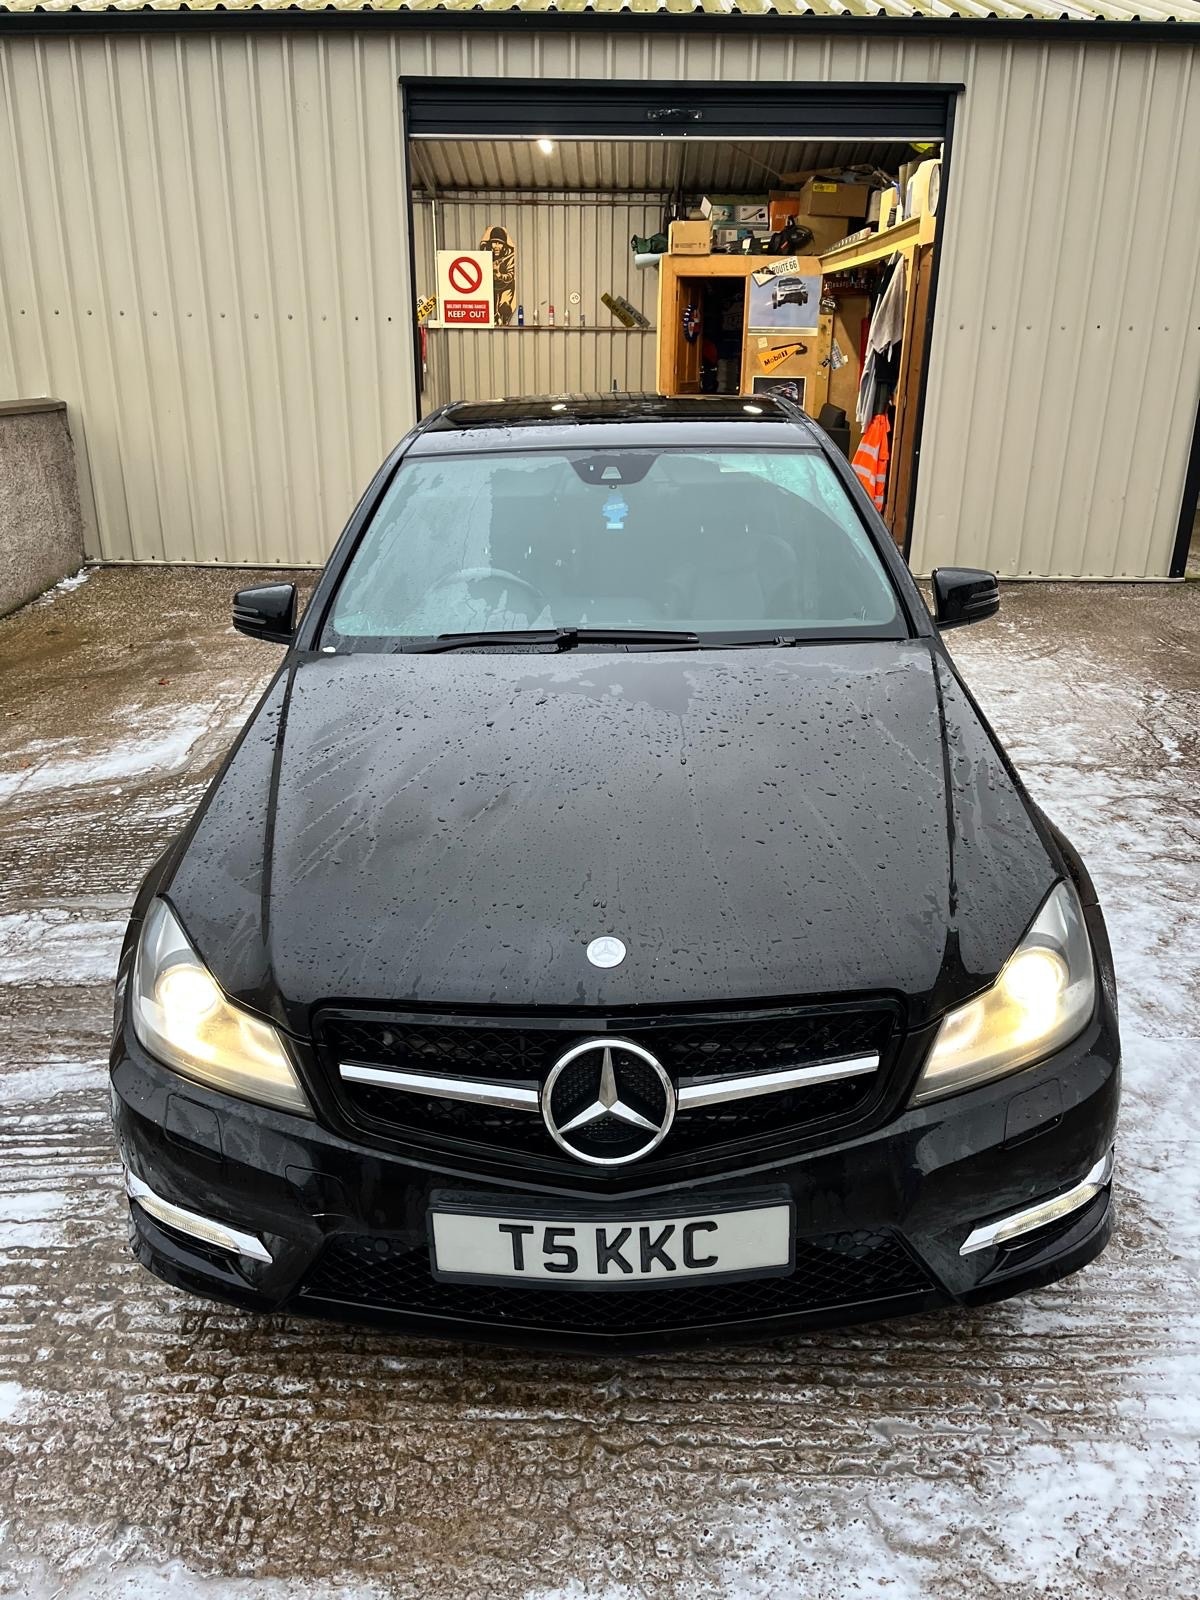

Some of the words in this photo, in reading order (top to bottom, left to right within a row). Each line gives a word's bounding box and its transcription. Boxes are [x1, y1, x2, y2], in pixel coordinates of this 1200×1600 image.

[789, 260, 798, 270] 66
[499, 1223, 579, 1275] T5
[596, 1221, 719, 1275] KKC
